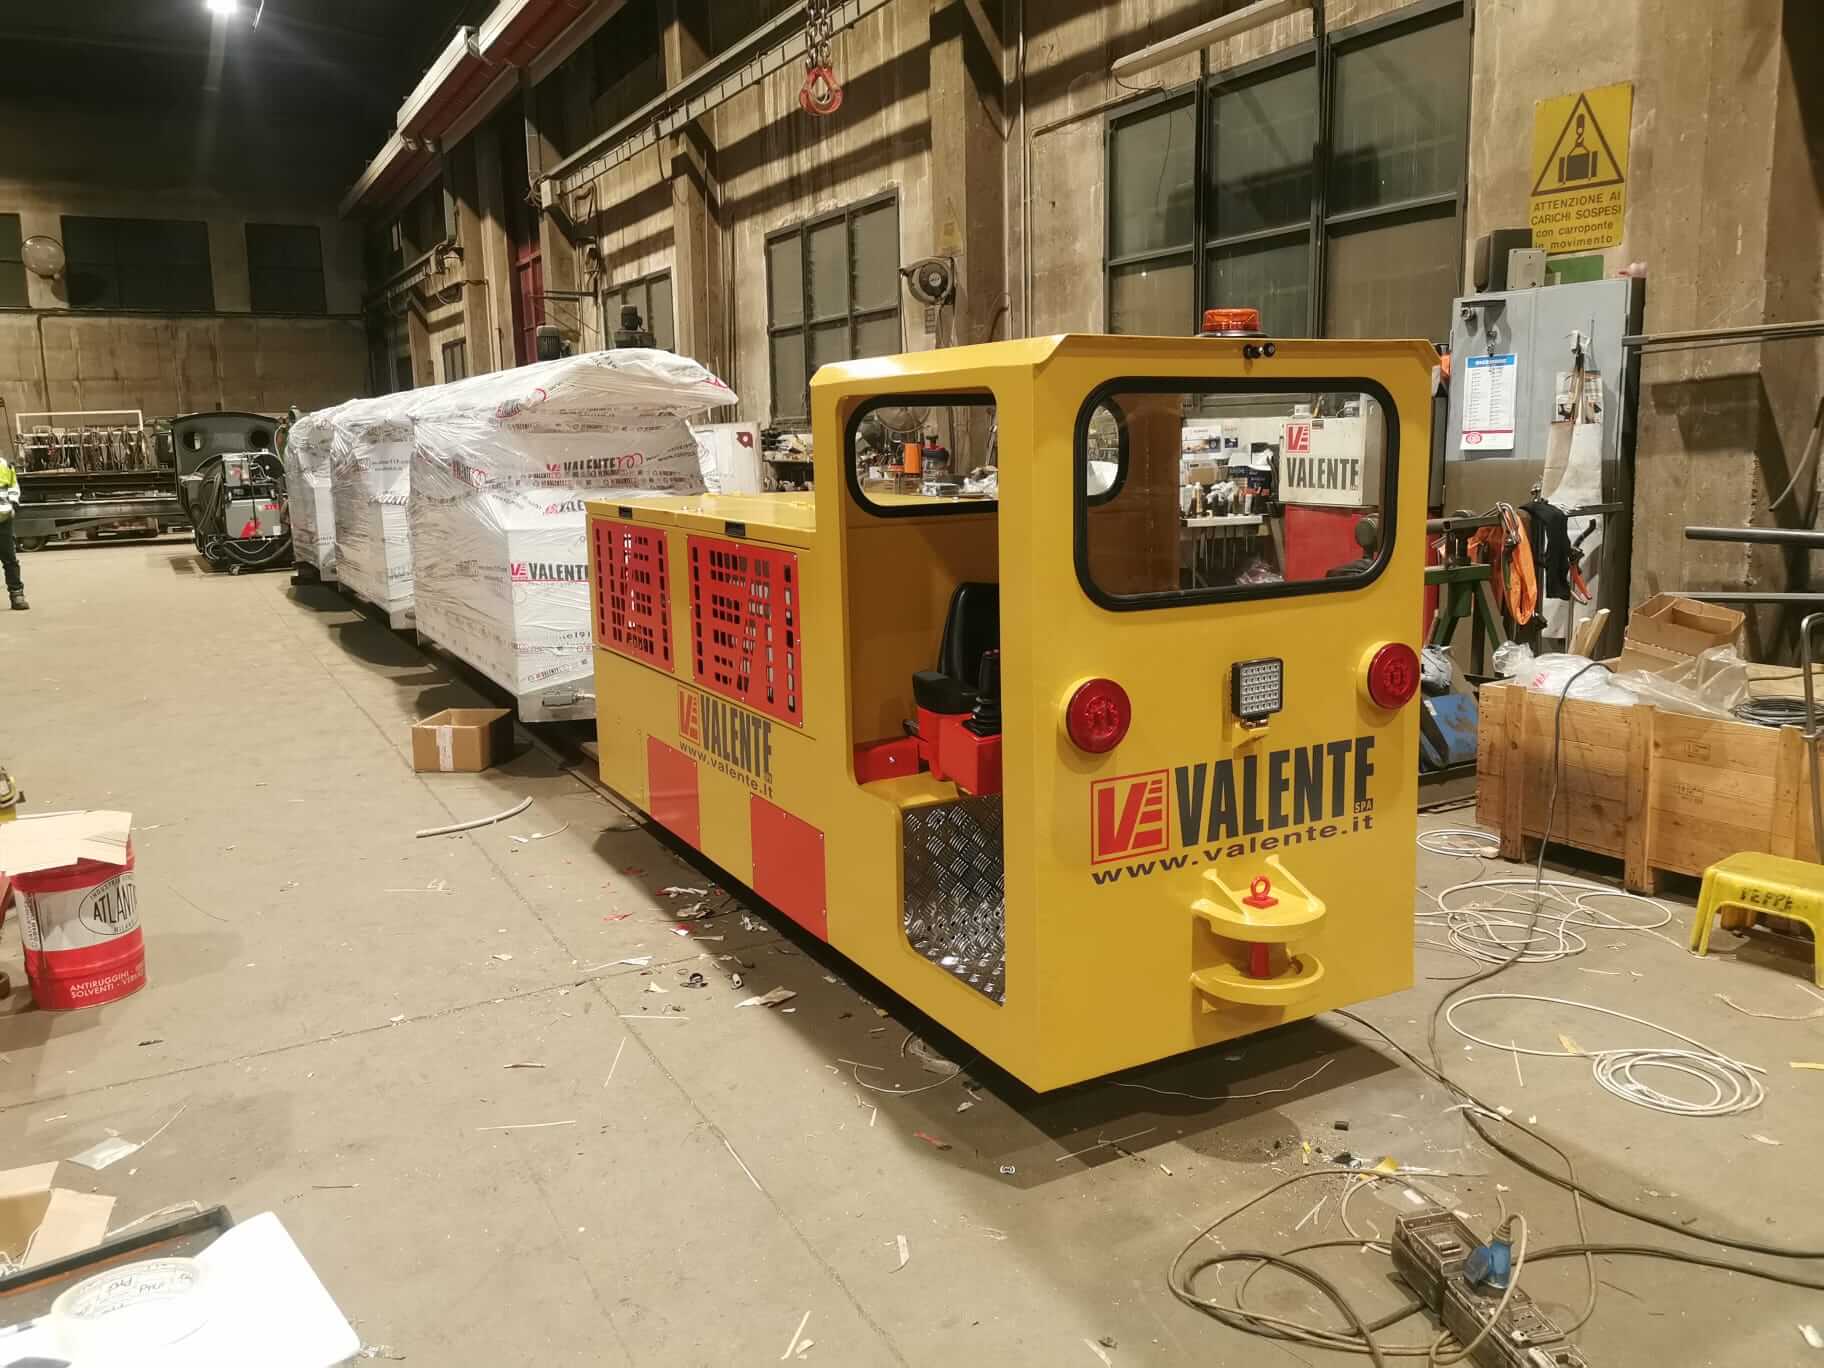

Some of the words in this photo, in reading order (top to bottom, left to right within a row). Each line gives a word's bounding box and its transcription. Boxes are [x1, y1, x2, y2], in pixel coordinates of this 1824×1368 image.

[1533, 193, 1604, 213] ATTENZIONE
[1609, 191, 1621, 201] AI
[1531, 212, 1571, 226] CARICHI
[1575, 205, 1622, 220] SOSPESI
[1535, 227, 1554, 238] con
[1558, 220, 1614, 238] carroponte
[1551, 236, 1613, 250] movimento
[1286, 457, 1360, 490] VALENTE
[528, 563, 588, 581] VALENT
[700, 694, 772, 778] VALENTE
[680, 741, 773, 800] www.valente.it
[1174, 736, 1376, 848] VALENTE
[1353, 798, 1374, 814] SPA
[1091, 815, 1374, 885] www.valente.it
[93, 883, 138, 924] ATLANT
[70, 970, 130, 992] ANTIRUGGINI
[71, 983, 115, 999] SOLVENTI
